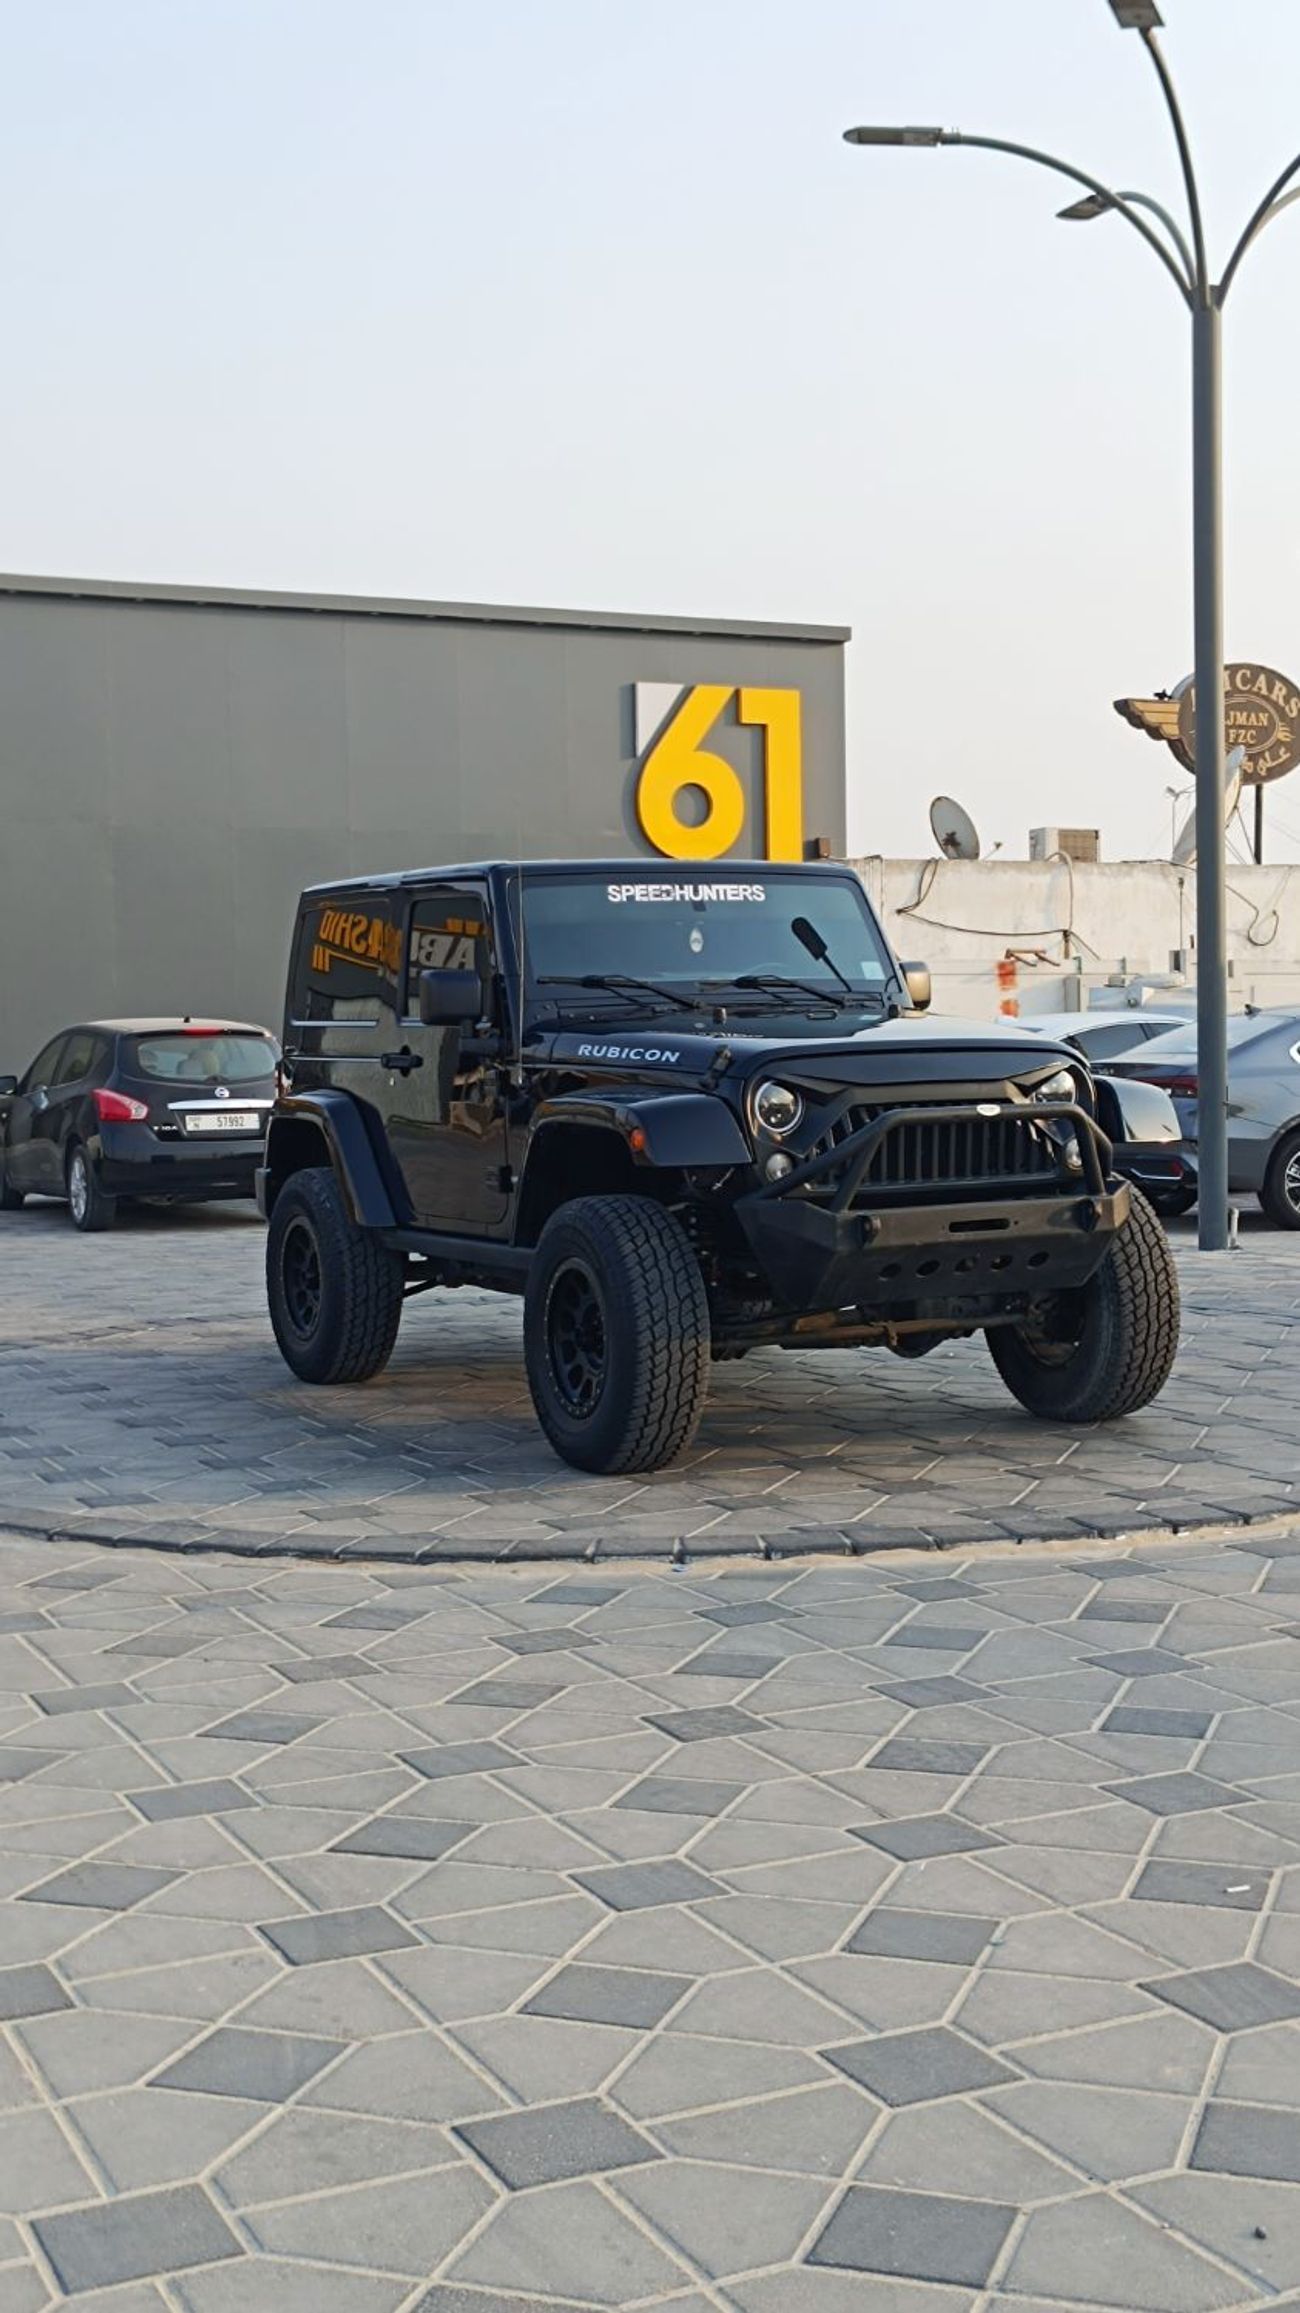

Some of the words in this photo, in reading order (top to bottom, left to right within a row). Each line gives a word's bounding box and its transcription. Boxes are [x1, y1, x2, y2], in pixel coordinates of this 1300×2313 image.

[1224, 711, 1269, 726] JMAN
[1229, 729, 1256, 744] FZC
[636, 683, 803, 862] 61
[607, 884, 765, 901] SPEEDHUNTERS
[578, 1044, 679, 1063] RUBICON
